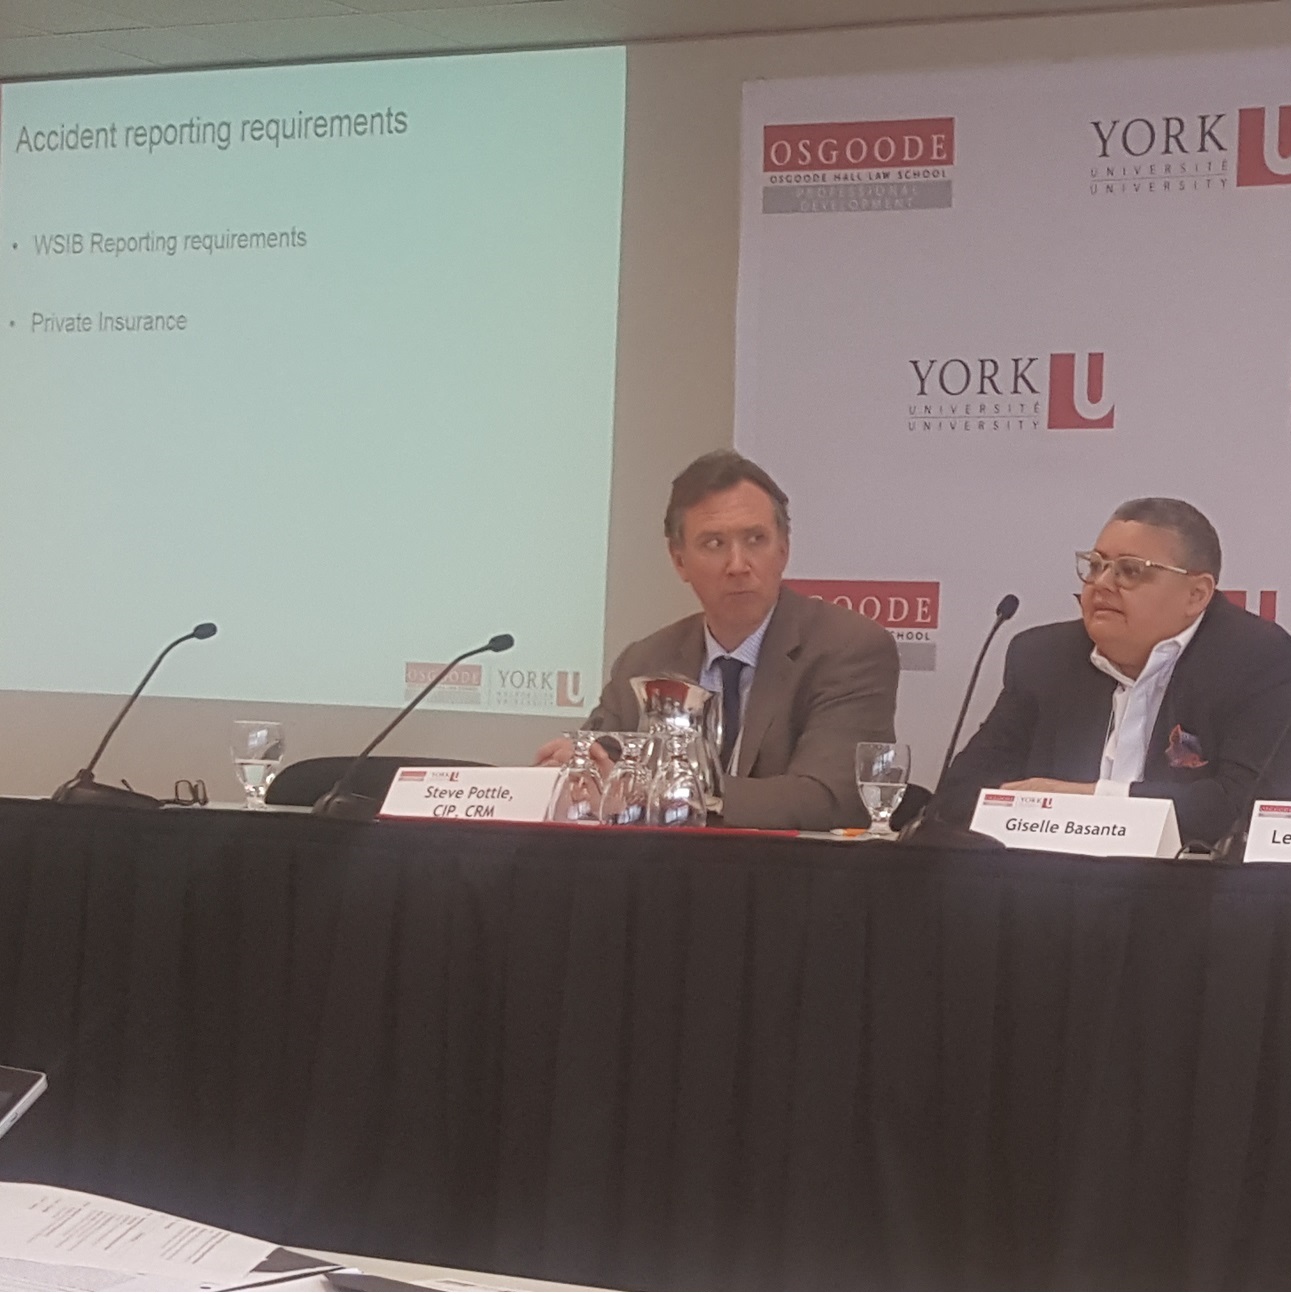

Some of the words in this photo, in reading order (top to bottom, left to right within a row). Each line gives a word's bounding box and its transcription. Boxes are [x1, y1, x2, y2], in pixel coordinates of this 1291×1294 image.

[16, 124, 117, 152] Accident
[125, 117, 231, 153] reporting
[241, 107, 408, 148] requirements
[1090, 113, 1227, 157] YORK
[770, 134, 947, 166] OSGOODE
[770, 173, 827, 184] OSGOODE
[869, 171, 891, 181] LAW
[898, 169, 947, 180] SCHOOL
[1090, 159, 1227, 178] UNIVERSITÉ
[1090, 179, 1227, 195] UNIVERSITY
[34, 233, 83, 255] WSIB
[90, 231, 177, 257] Reporting
[184, 226, 307, 255] requirements
[31, 312, 92, 333] Private
[99, 311, 187, 331] Insurance
[909, 357, 1040, 396] YORK
[909, 401, 1040, 415] UNIVERSITÉ
[908, 420, 1040, 431] UNIVERSITY
[498, 670, 553, 690] YORK
[424, 786, 464, 799] Steve
[467, 786, 513, 801] Pottle,
[465, 805, 495, 818] CRM
[1005, 818, 1059, 833] Giselle
[1064, 821, 1127, 837] Basanta
